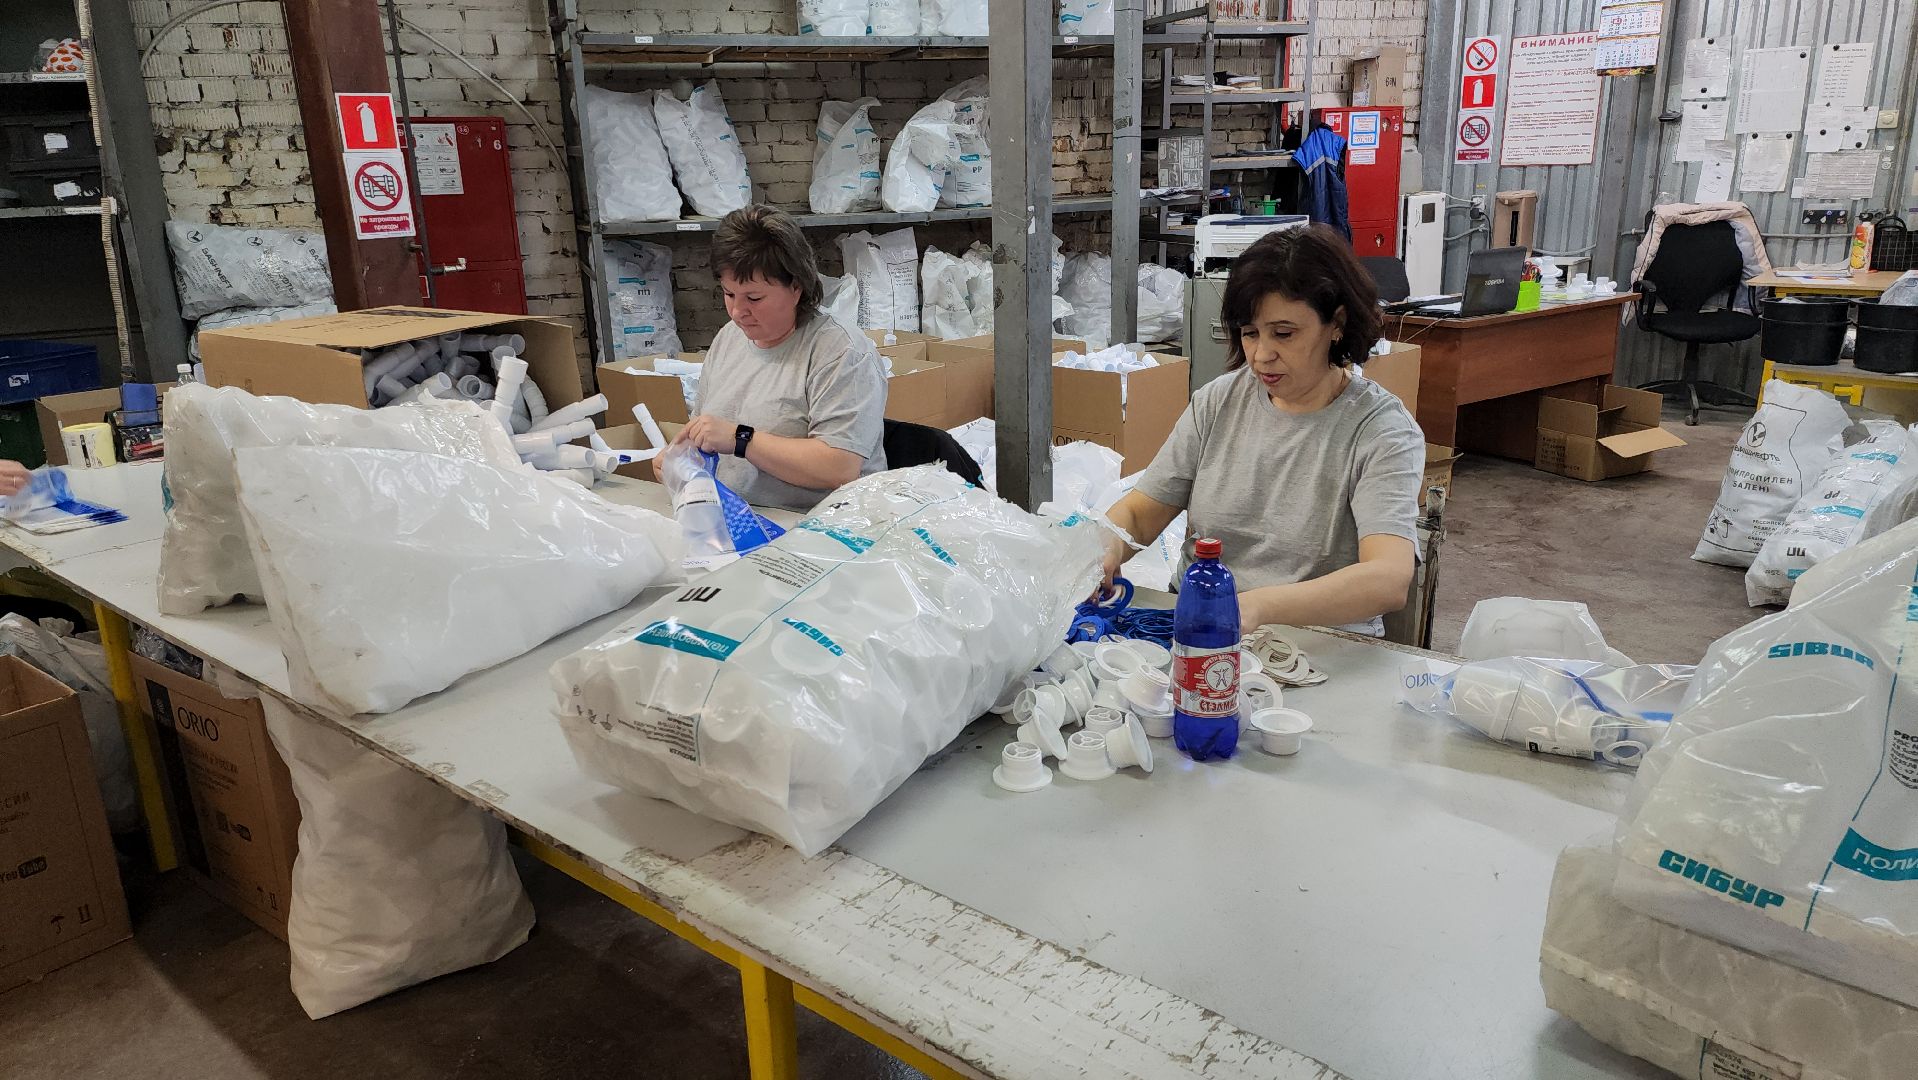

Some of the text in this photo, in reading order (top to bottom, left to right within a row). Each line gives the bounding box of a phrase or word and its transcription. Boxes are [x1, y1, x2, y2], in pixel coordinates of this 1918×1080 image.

[1393, 123, 1400, 132] 5
[493, 139, 502, 150] 6
[676, 586, 722, 603] ПП
[1767, 641, 1875, 671] SIBUR
[177, 706, 219, 742] ORIO
[1658, 849, 1786, 909] СИБУР
